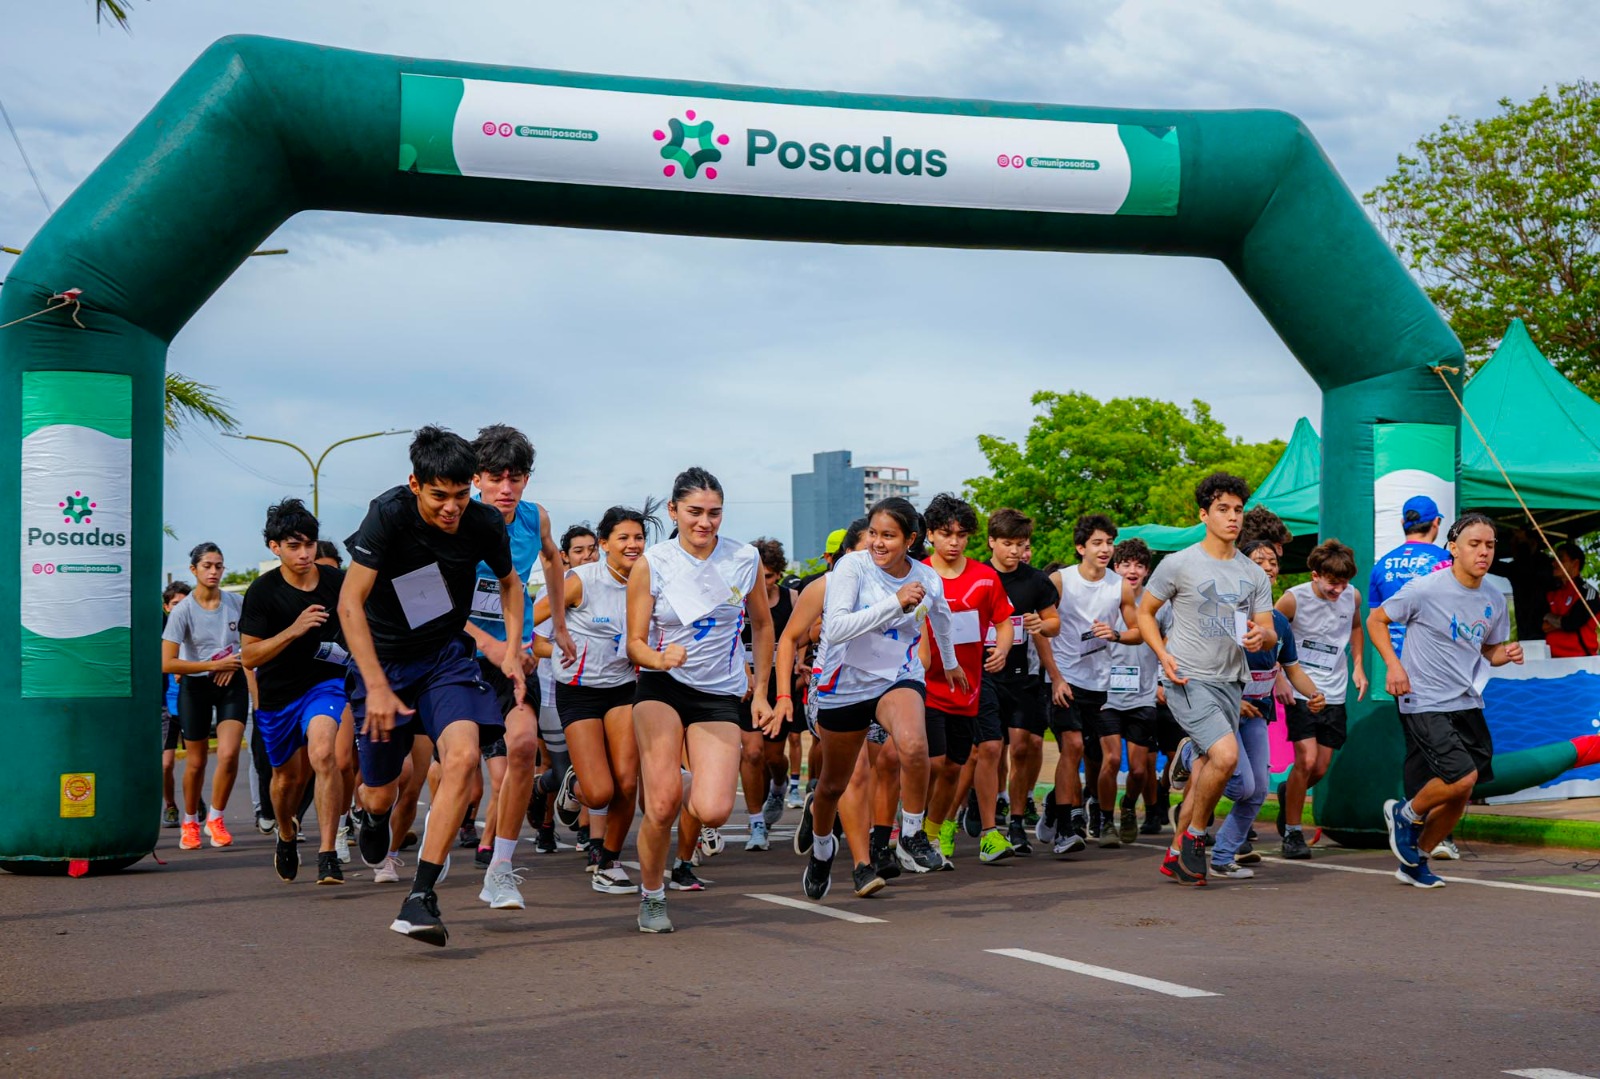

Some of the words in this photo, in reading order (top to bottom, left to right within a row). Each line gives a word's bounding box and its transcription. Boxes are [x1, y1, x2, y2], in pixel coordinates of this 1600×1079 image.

[520, 126, 593, 139] @muniposadas
[746, 128, 948, 177] Posadas
[1030, 158, 1095, 170] @muniposadas
[28, 527, 126, 546] Posadas
[60, 564, 118, 573] @muniposadas
[1385, 557, 1429, 569] STAFF
[693, 617, 716, 641] 9
